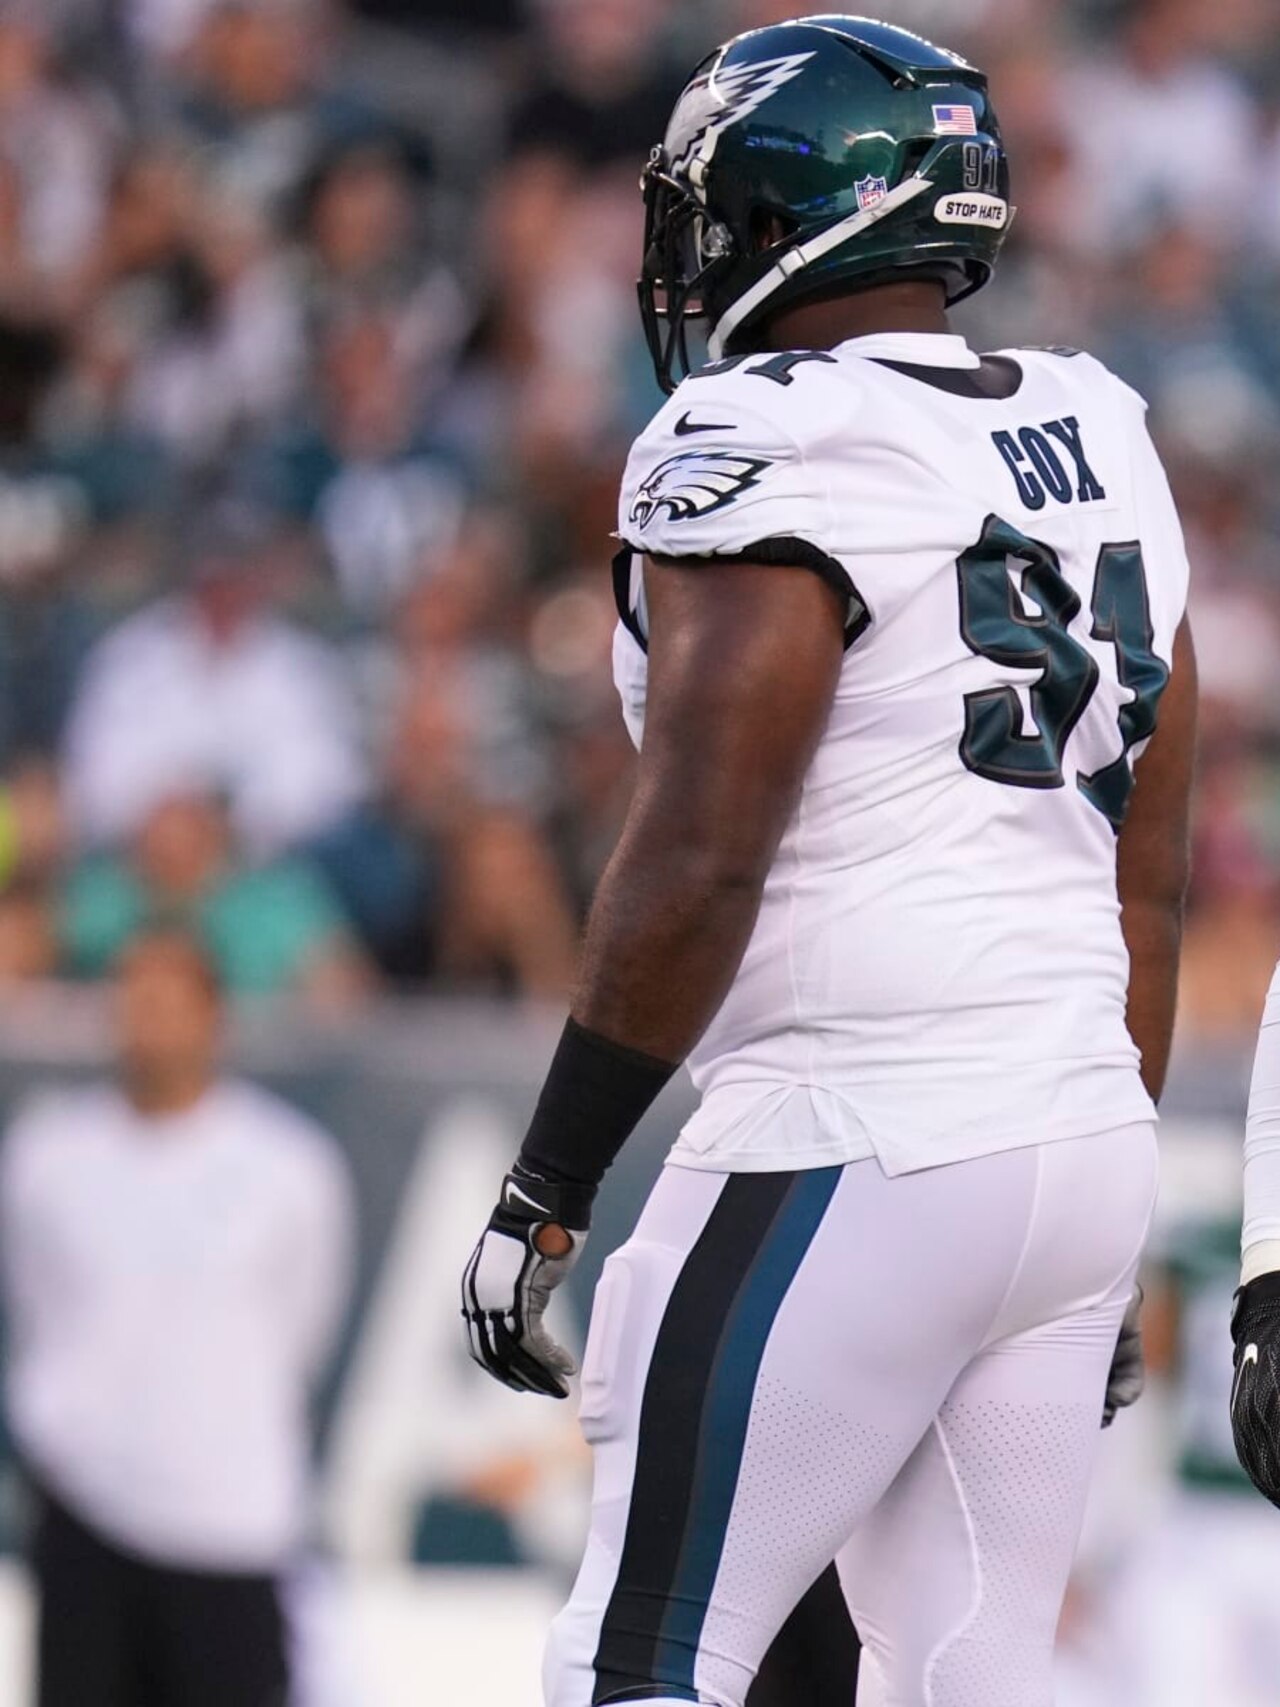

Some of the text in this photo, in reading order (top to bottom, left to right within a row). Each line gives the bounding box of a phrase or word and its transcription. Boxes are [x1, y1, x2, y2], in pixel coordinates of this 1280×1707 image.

[963, 142, 998, 193] 91
[945, 201, 1002, 220] STOP HATE
[991, 416, 1105, 511] COX
[956, 513, 1169, 835] 91
